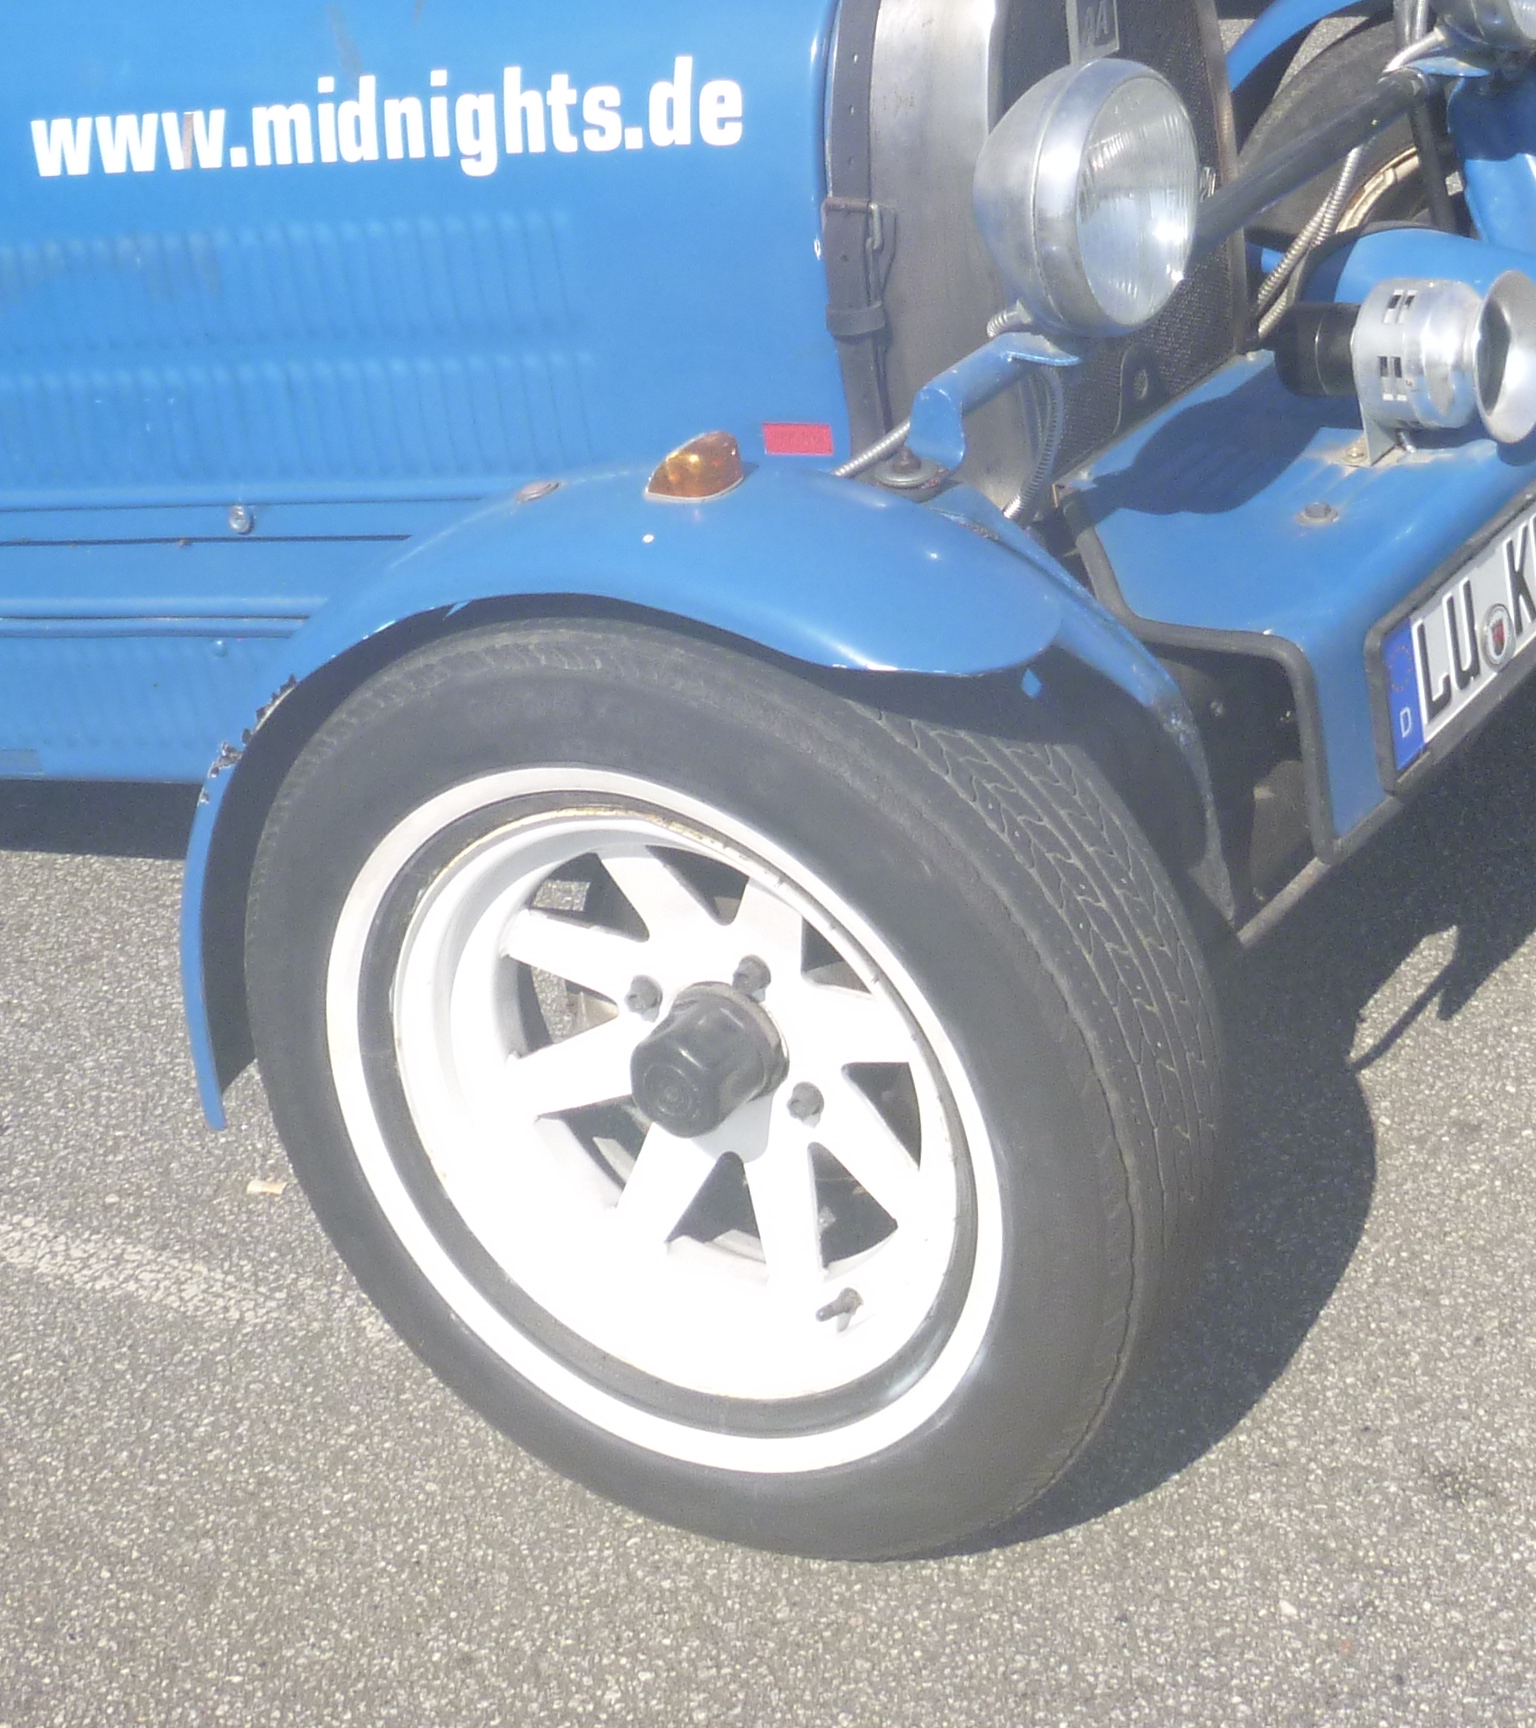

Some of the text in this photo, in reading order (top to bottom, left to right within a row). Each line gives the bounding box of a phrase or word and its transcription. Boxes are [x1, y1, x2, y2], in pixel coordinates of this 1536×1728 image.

[31, 55, 744, 177] www.midnights.de
[1412, 576, 1481, 726] LU
[1398, 707, 1414, 738] D
